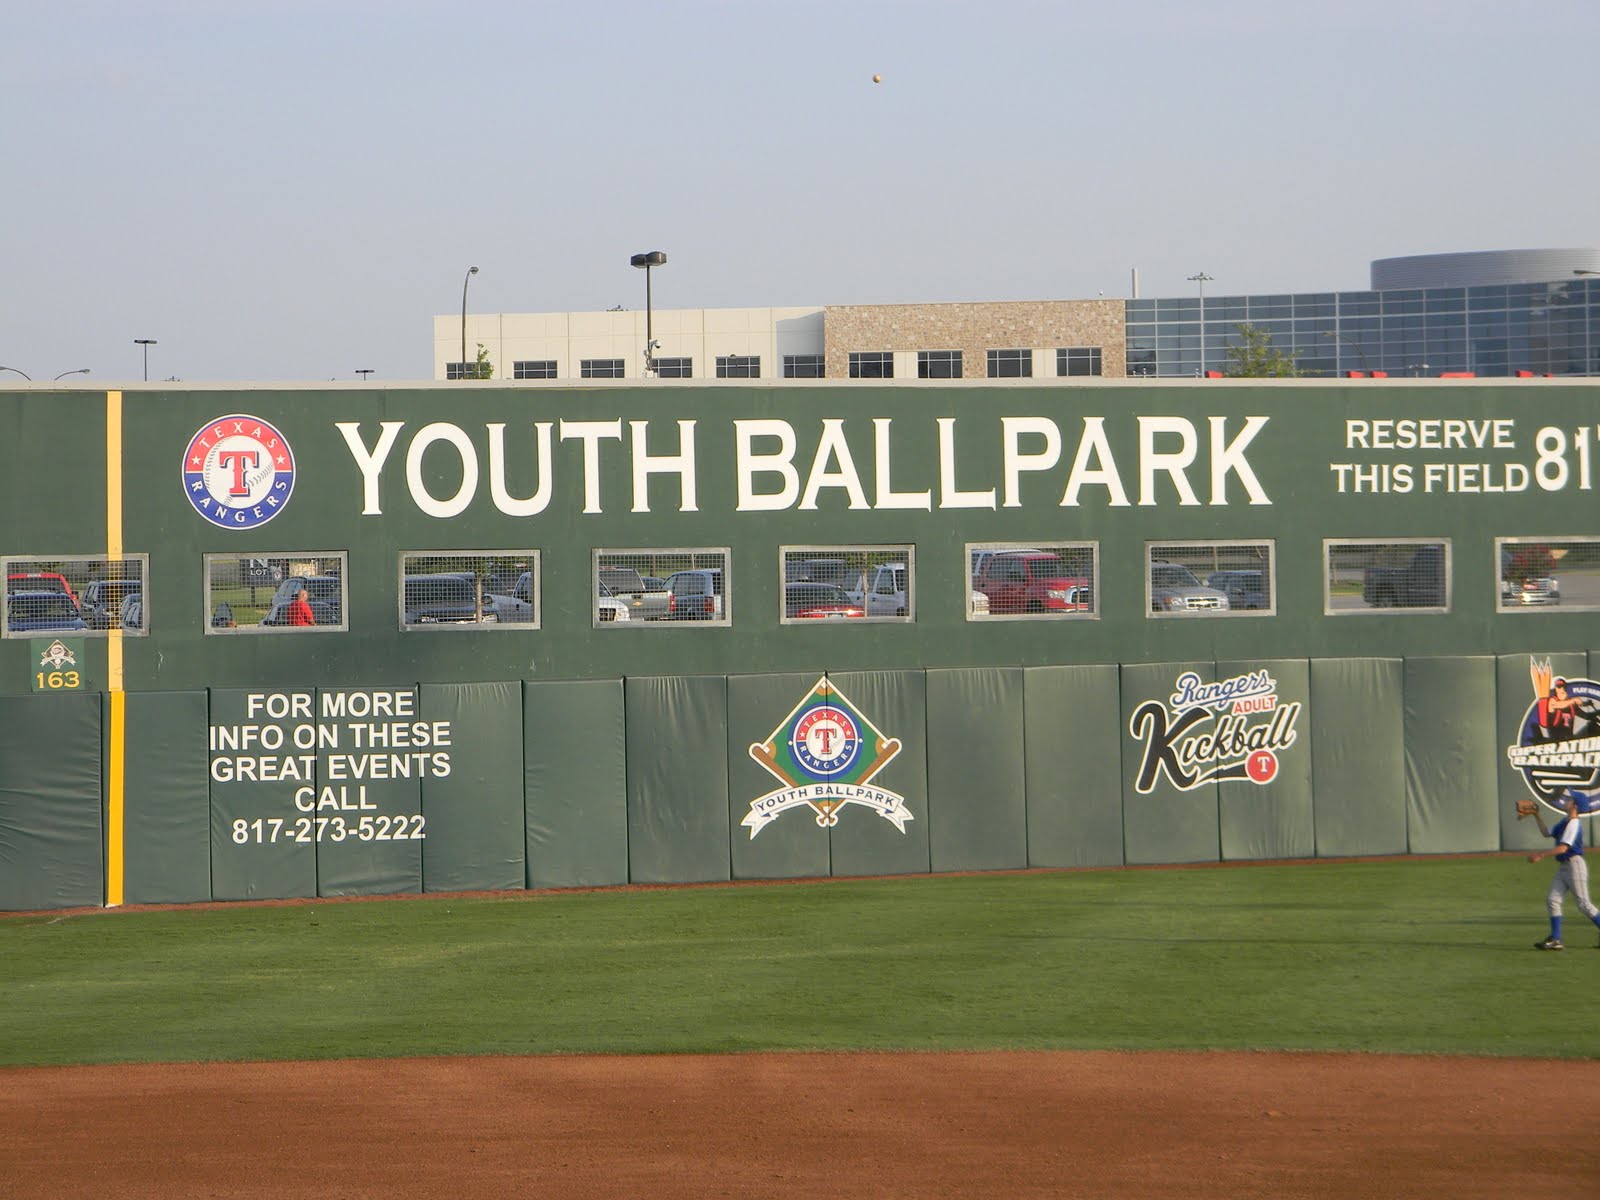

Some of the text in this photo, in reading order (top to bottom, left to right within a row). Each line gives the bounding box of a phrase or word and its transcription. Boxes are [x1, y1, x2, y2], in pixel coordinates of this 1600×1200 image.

[199, 421, 279, 449] TEXAS
[1346, 419, 1515, 449] RESERVE
[334, 416, 1273, 518] YOUTH BALLPARK
[1535, 424, 1600, 491] 81
[219, 450, 259, 497] T
[1330, 463, 1529, 493] THIS FIELD
[191, 480, 287, 523] RANGERS
[250, 568, 267, 576] LOT
[37, 671, 80, 689] 163
[1171, 669, 1277, 712] Rangers
[247, 691, 414, 719] FOR MORE
[1233, 697, 1277, 715] ADULT
[803, 711, 848, 729] TEXAS
[210, 721, 451, 751] INFO ON THESE
[814, 728, 837, 755] T
[1130, 700, 1301, 794] Kickball
[1510, 736, 1600, 757] OPERATIO
[210, 752, 451, 782] GREAT EVENTS
[799, 744, 853, 769] RANGERS
[1257, 757, 1270, 773] T
[294, 785, 377, 812] CALL
[757, 786, 896, 812] YOUTH BALLPARK
[231, 815, 427, 844] 817-273-5222
